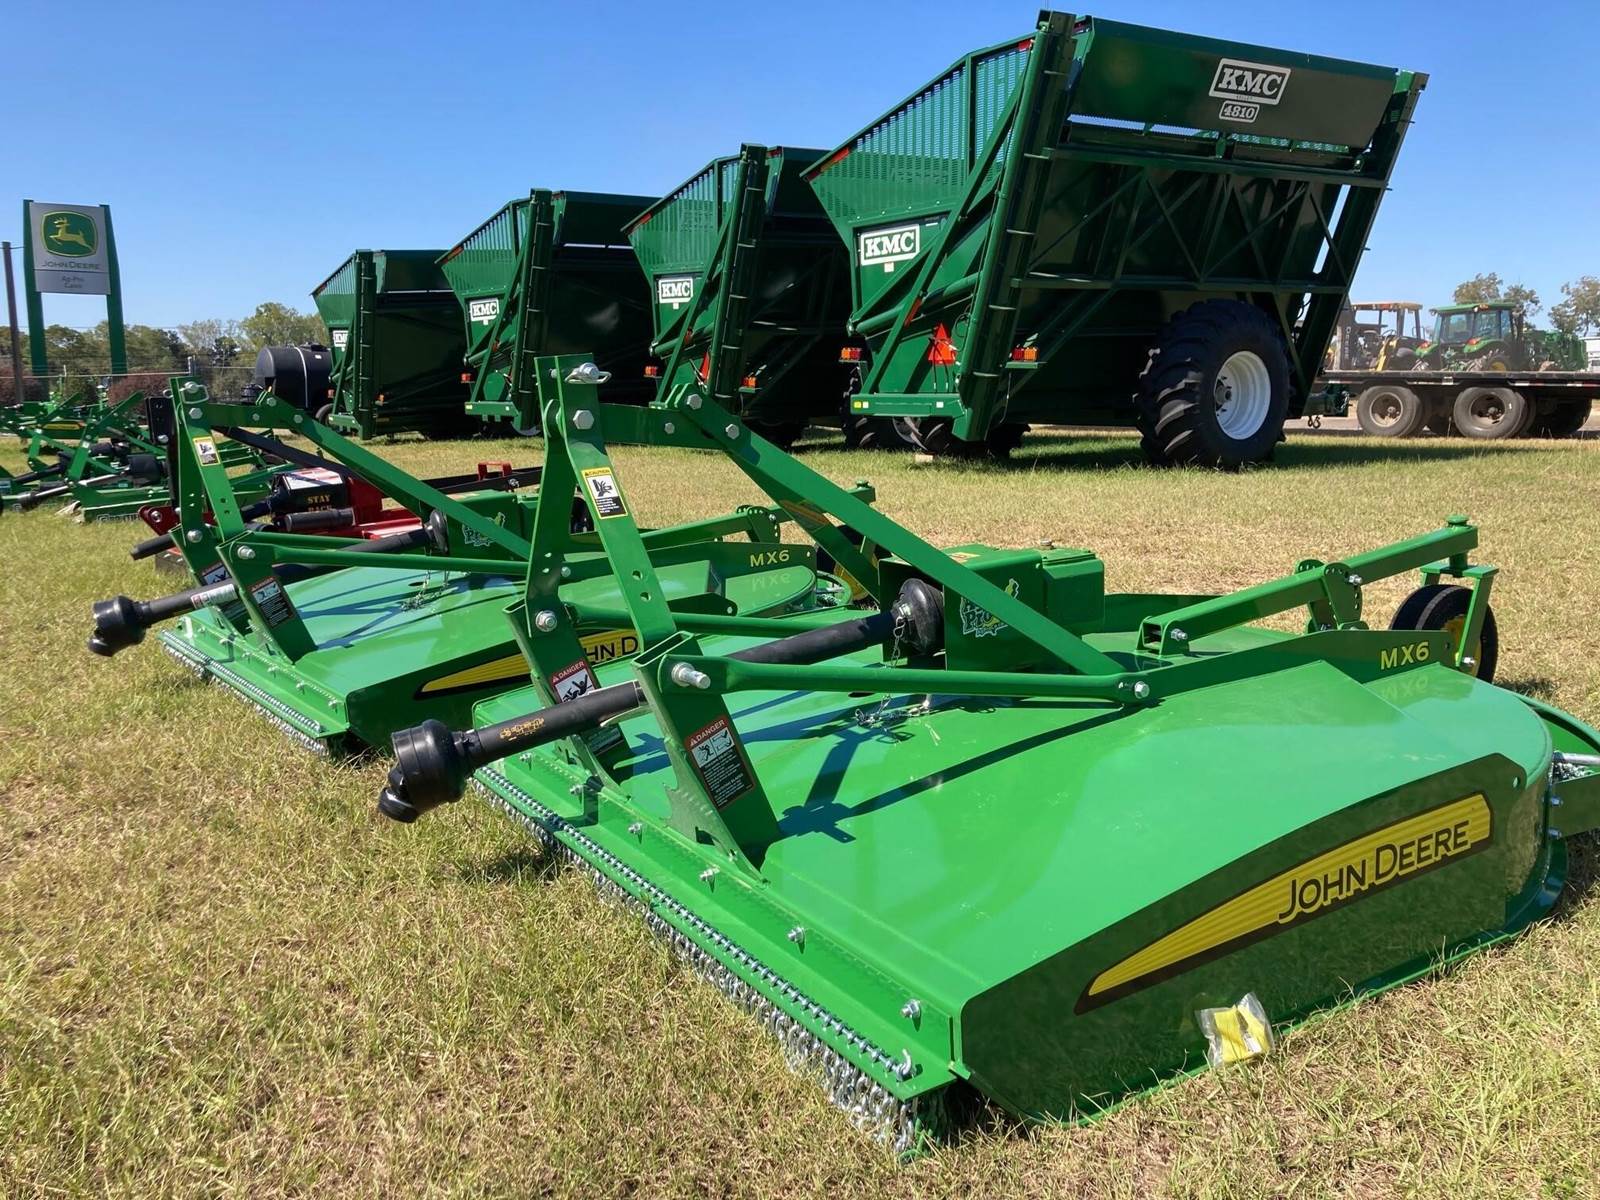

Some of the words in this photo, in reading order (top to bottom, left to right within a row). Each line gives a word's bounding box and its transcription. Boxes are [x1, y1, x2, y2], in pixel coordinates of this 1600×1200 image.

[1218, 68, 1282, 95] KMC
[1223, 104, 1256, 119] 4810
[865, 231, 915, 257] KMC
[661, 281, 690, 297] KMC
[473, 302, 497, 317] KMC
[307, 494, 331, 504] STAY
[750, 550, 790, 567] MX6
[1380, 641, 1429, 670] MX6
[558, 661, 585, 679] DANGER
[696, 719, 725, 740] DANGER
[1278, 859, 1367, 920] JOHN
[1374, 820, 1470, 882] DEERE
